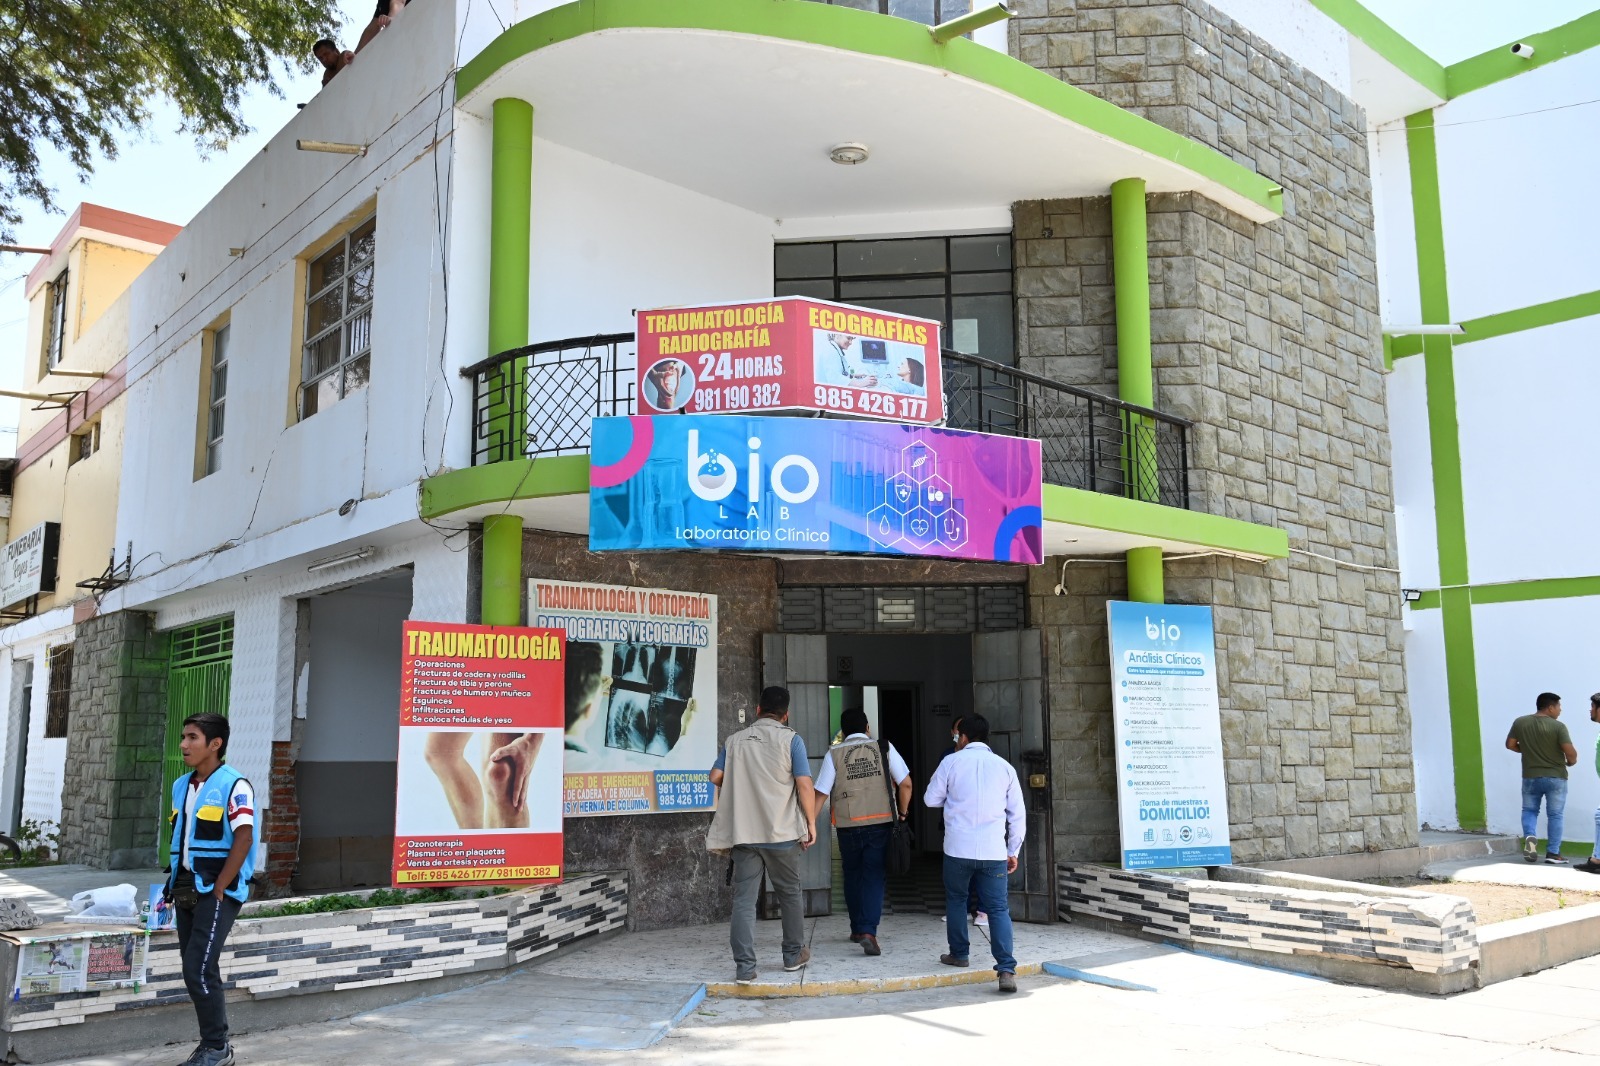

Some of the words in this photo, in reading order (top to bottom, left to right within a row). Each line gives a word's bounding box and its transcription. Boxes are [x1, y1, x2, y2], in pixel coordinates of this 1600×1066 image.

[646, 302, 785, 334] TRAUMATOLOGÍA
[809, 307, 928, 345] ECOGRAFÍAS
[659, 326, 770, 354] RADIOGRAFÍA
[698, 352, 733, 382] 24
[734, 355, 783, 379] HORAS
[695, 388, 720, 411] 981
[723, 385, 749, 410] 190
[752, 383, 781, 407] 382
[814, 386, 854, 410] 985
[858, 392, 896, 415] 426
[899, 398, 927, 418] 177
[688, 429, 820, 504] bio
[676, 526, 770, 540] Laboratorio
[775, 527, 830, 542] Clínico
[8, 526, 42, 562] FUNERARIA
[536, 584, 637, 614] TRAUMATOLOGÍA
[639, 591, 647, 614] Y
[649, 592, 709, 619] ORTOPEDÍA
[630, 620, 638, 643] Y
[639, 621, 708, 648] ECOGRAFÍAS
[1146, 616, 1180, 640] bio
[407, 630, 561, 660] TRAUMATOLOGÍA
[414, 660, 465, 669] Operaciones
[1128, 652, 1163, 664] Análisis
[1166, 653, 1201, 665] Clínicos
[413, 697, 452, 705] Esguinces
[588, 776, 598, 788] DE
[602, 774, 649, 788] EMERGENCIA
[658, 783, 673, 794] 981
[676, 783, 691, 793] 190
[693, 783, 708, 793] 382
[568, 790, 576, 800] DE
[576, 789, 602, 799] CADERA
[603, 788, 608, 798] Y
[609, 788, 618, 798] DE
[619, 787, 645, 798] RODILLA
[659, 795, 675, 806] 985
[677, 795, 692, 805] 426
[694, 794, 708, 805] 177
[572, 802, 577, 812] Y
[579, 800, 605, 812] HERNIA
[606, 800, 616, 811] DE
[618, 798, 650, 810] COLUMNA
[1139, 806, 1210, 821] DOMICILIO!
[407, 840, 463, 848] Ozonoterapia
[466, 848, 506, 857] plaquetas
[406, 872, 427, 881] Telf:
[430, 870, 448, 880] 985
[451, 870, 469, 879] 426
[472, 869, 487, 878] 177
[489, 869, 494, 878] /
[496, 868, 512, 878] 981
[515, 868, 530, 877] 190
[533, 868, 550, 877] 382
